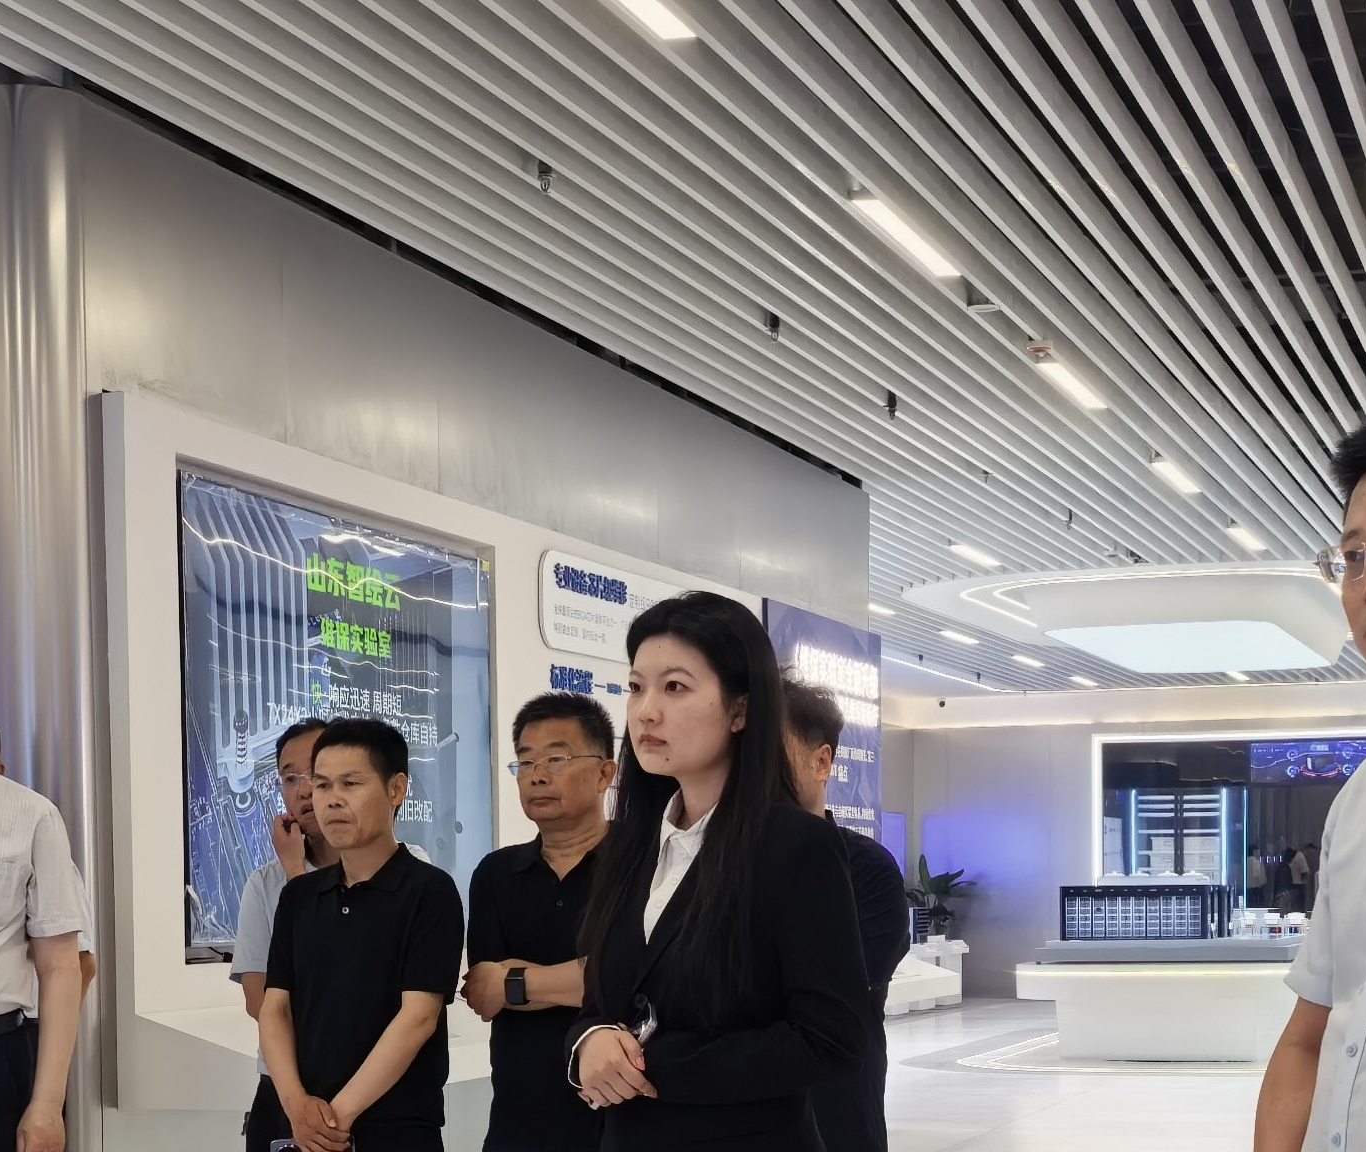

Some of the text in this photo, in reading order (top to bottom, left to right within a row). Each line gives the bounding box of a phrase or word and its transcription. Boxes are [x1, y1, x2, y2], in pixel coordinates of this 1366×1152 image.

[307, 552, 400, 611] 山东智绘云
[321, 617, 392, 659] 维保实验室
[329, 683, 370, 712] 响应迅速
[373, 690, 402, 717] 周期短
